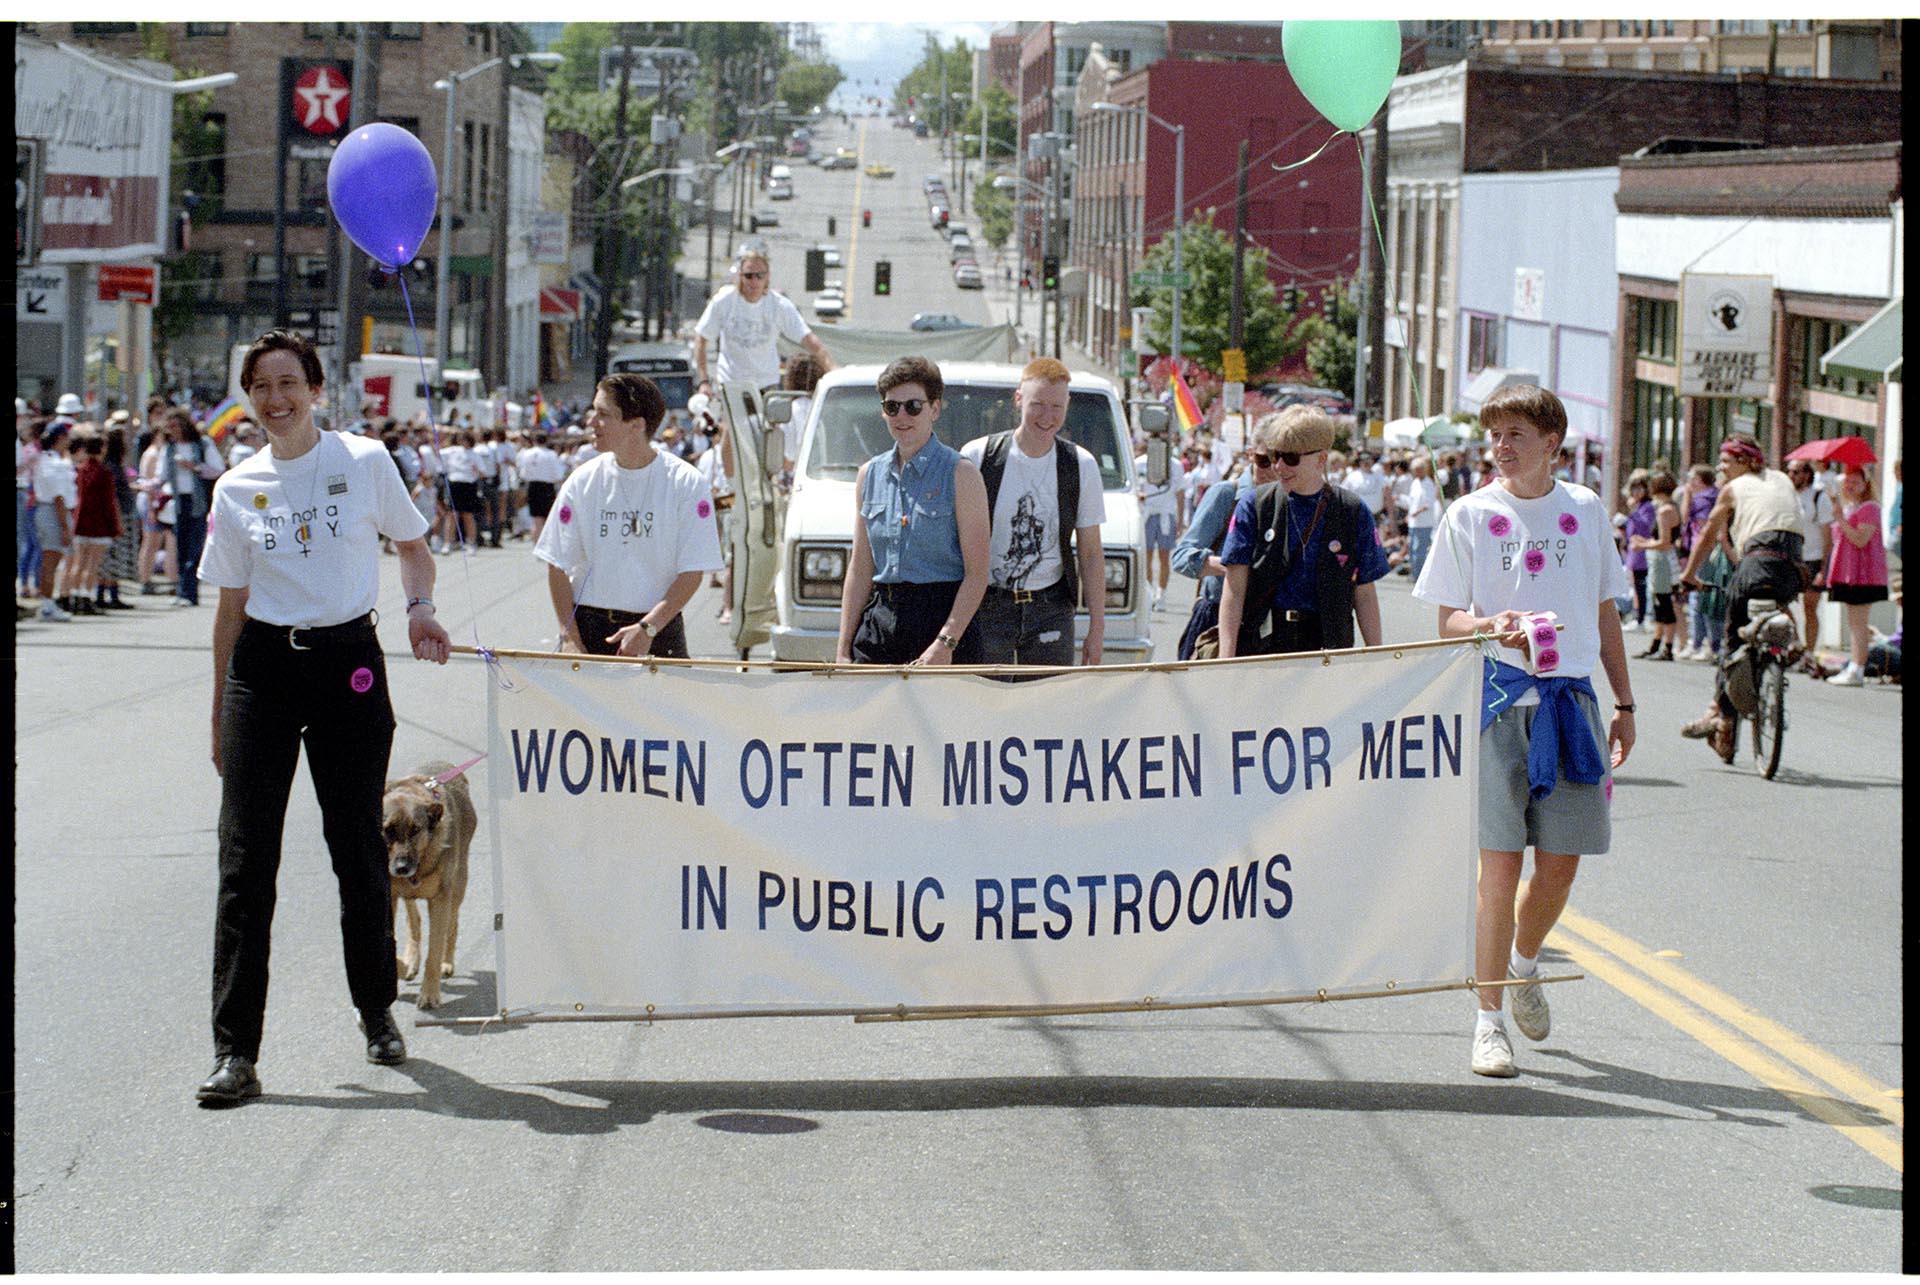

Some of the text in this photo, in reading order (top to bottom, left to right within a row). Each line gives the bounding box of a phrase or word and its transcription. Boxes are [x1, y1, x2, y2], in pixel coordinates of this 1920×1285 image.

[291, 507, 318, 526] not
[326, 505, 338, 518] a
[622, 510, 640, 521] not
[645, 511, 654, 521] a
[1500, 538, 1567, 554] i'm not a
[511, 713, 1463, 809] WOMEN OFTEN MISTAKEN FOR MEN
[681, 853, 1294, 943] IN PUBLIC RESTROOMS
